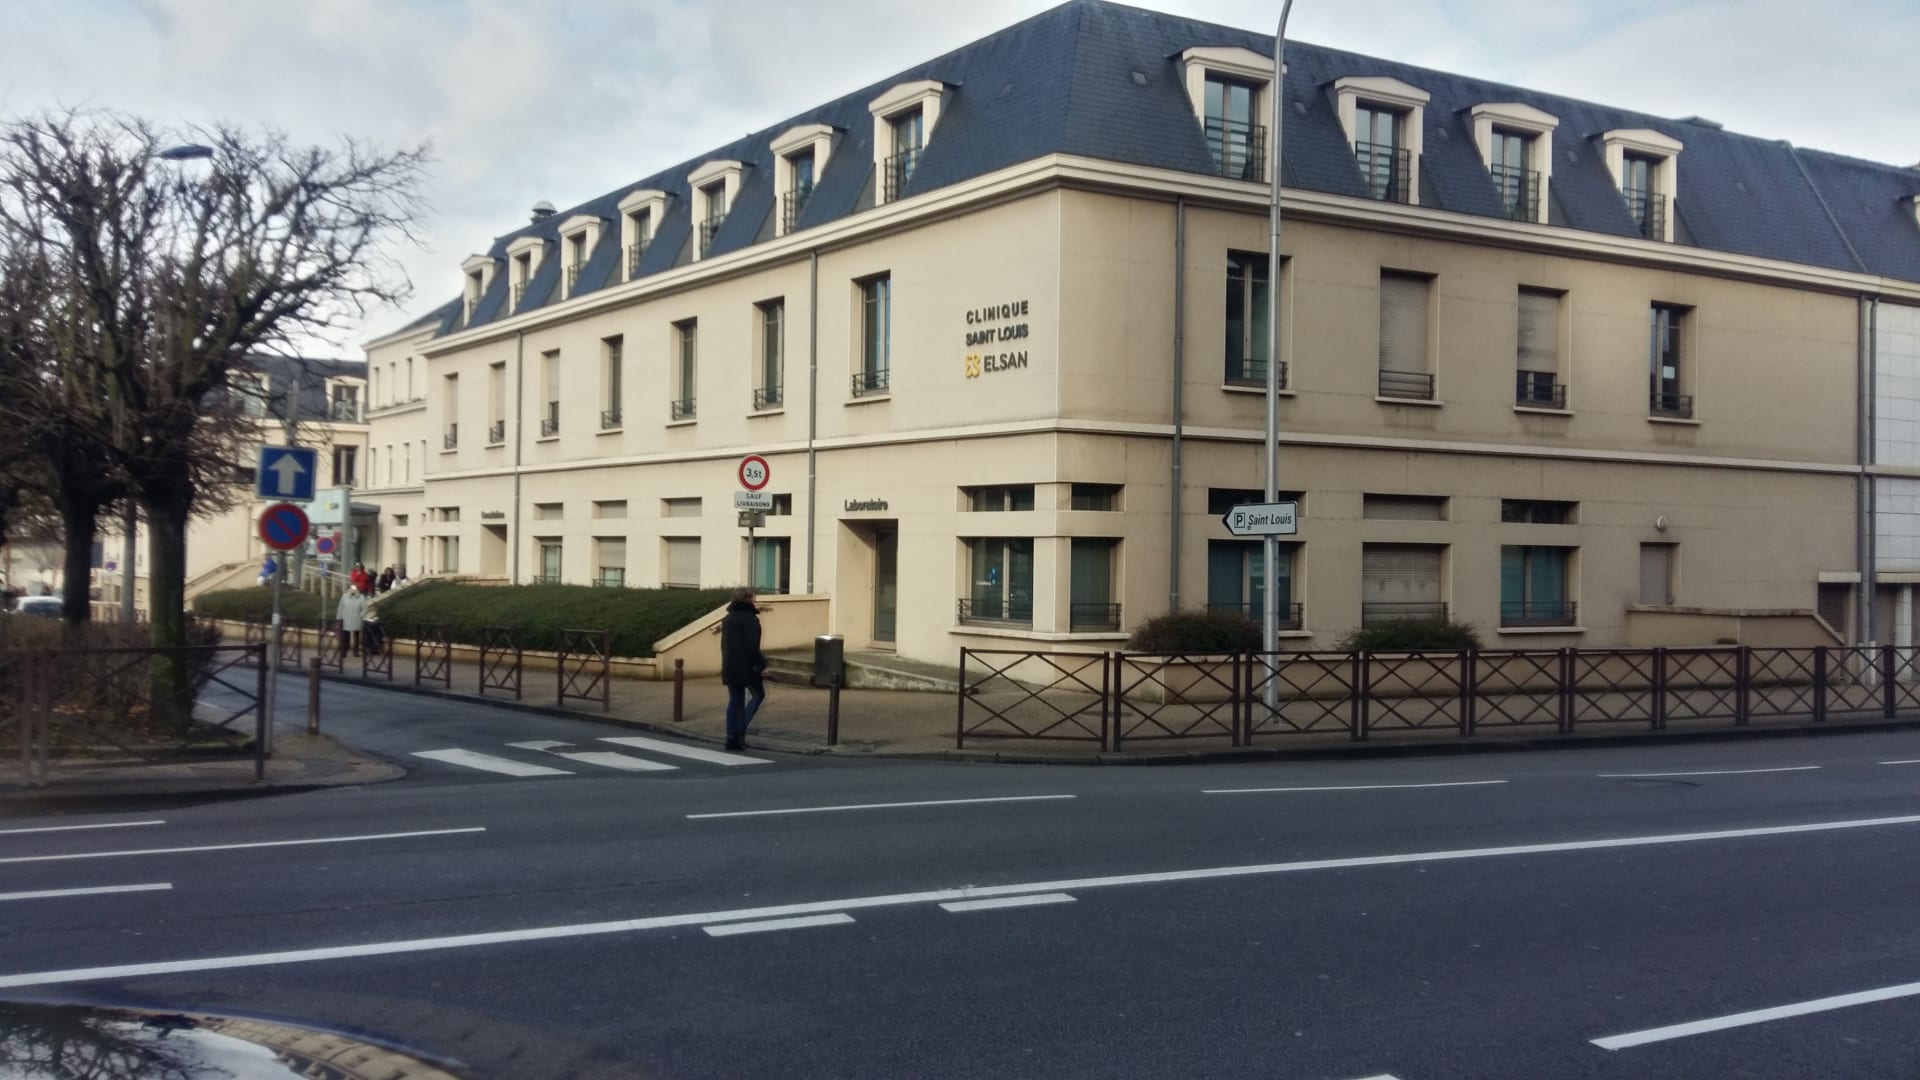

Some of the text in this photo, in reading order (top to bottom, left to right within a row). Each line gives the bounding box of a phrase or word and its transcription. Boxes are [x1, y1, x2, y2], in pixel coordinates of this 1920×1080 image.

[966, 300, 1029, 325] CLINIQUE
[966, 323, 1029, 347] SAINT LOUIS
[983, 350, 1028, 373] ELSAN
[745, 468, 762, 479] 3,5t
[737, 500, 770, 508] LIVRAISONS
[844, 497, 889, 512] Laboratoire
[1236, 512, 1292, 526] P Saint Louis
